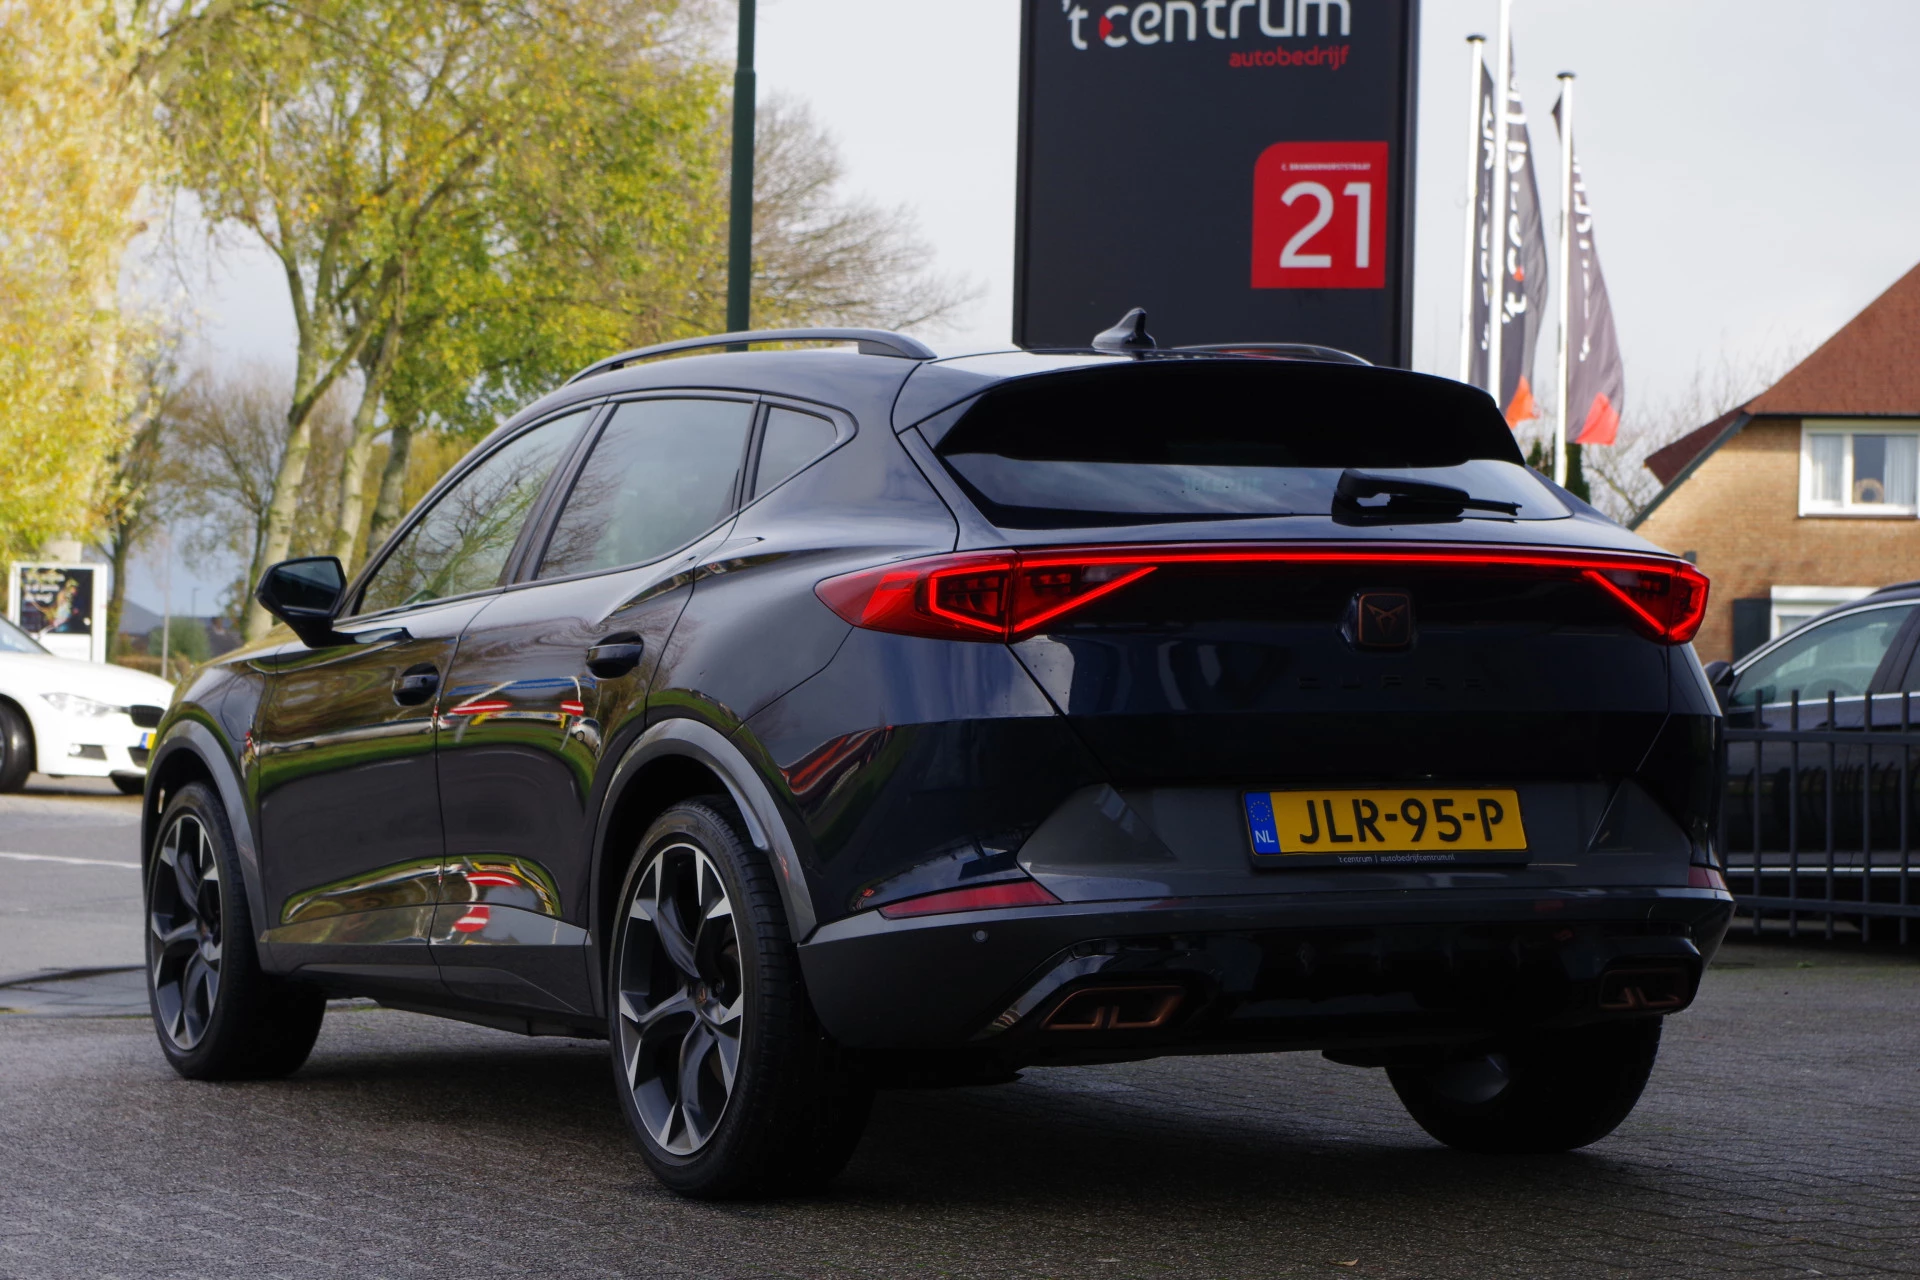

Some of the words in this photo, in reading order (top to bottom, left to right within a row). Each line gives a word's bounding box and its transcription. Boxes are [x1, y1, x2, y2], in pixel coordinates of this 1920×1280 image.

[1100, 0, 1350, 48] centrum
[1229, 45, 1350, 70] autobedrijf
[1279, 181, 1371, 269] 21
[1254, 830, 1275, 844] NL
[1299, 798, 1504, 845] JLR-95-P
[1344, 855, 1373, 863] centrum
